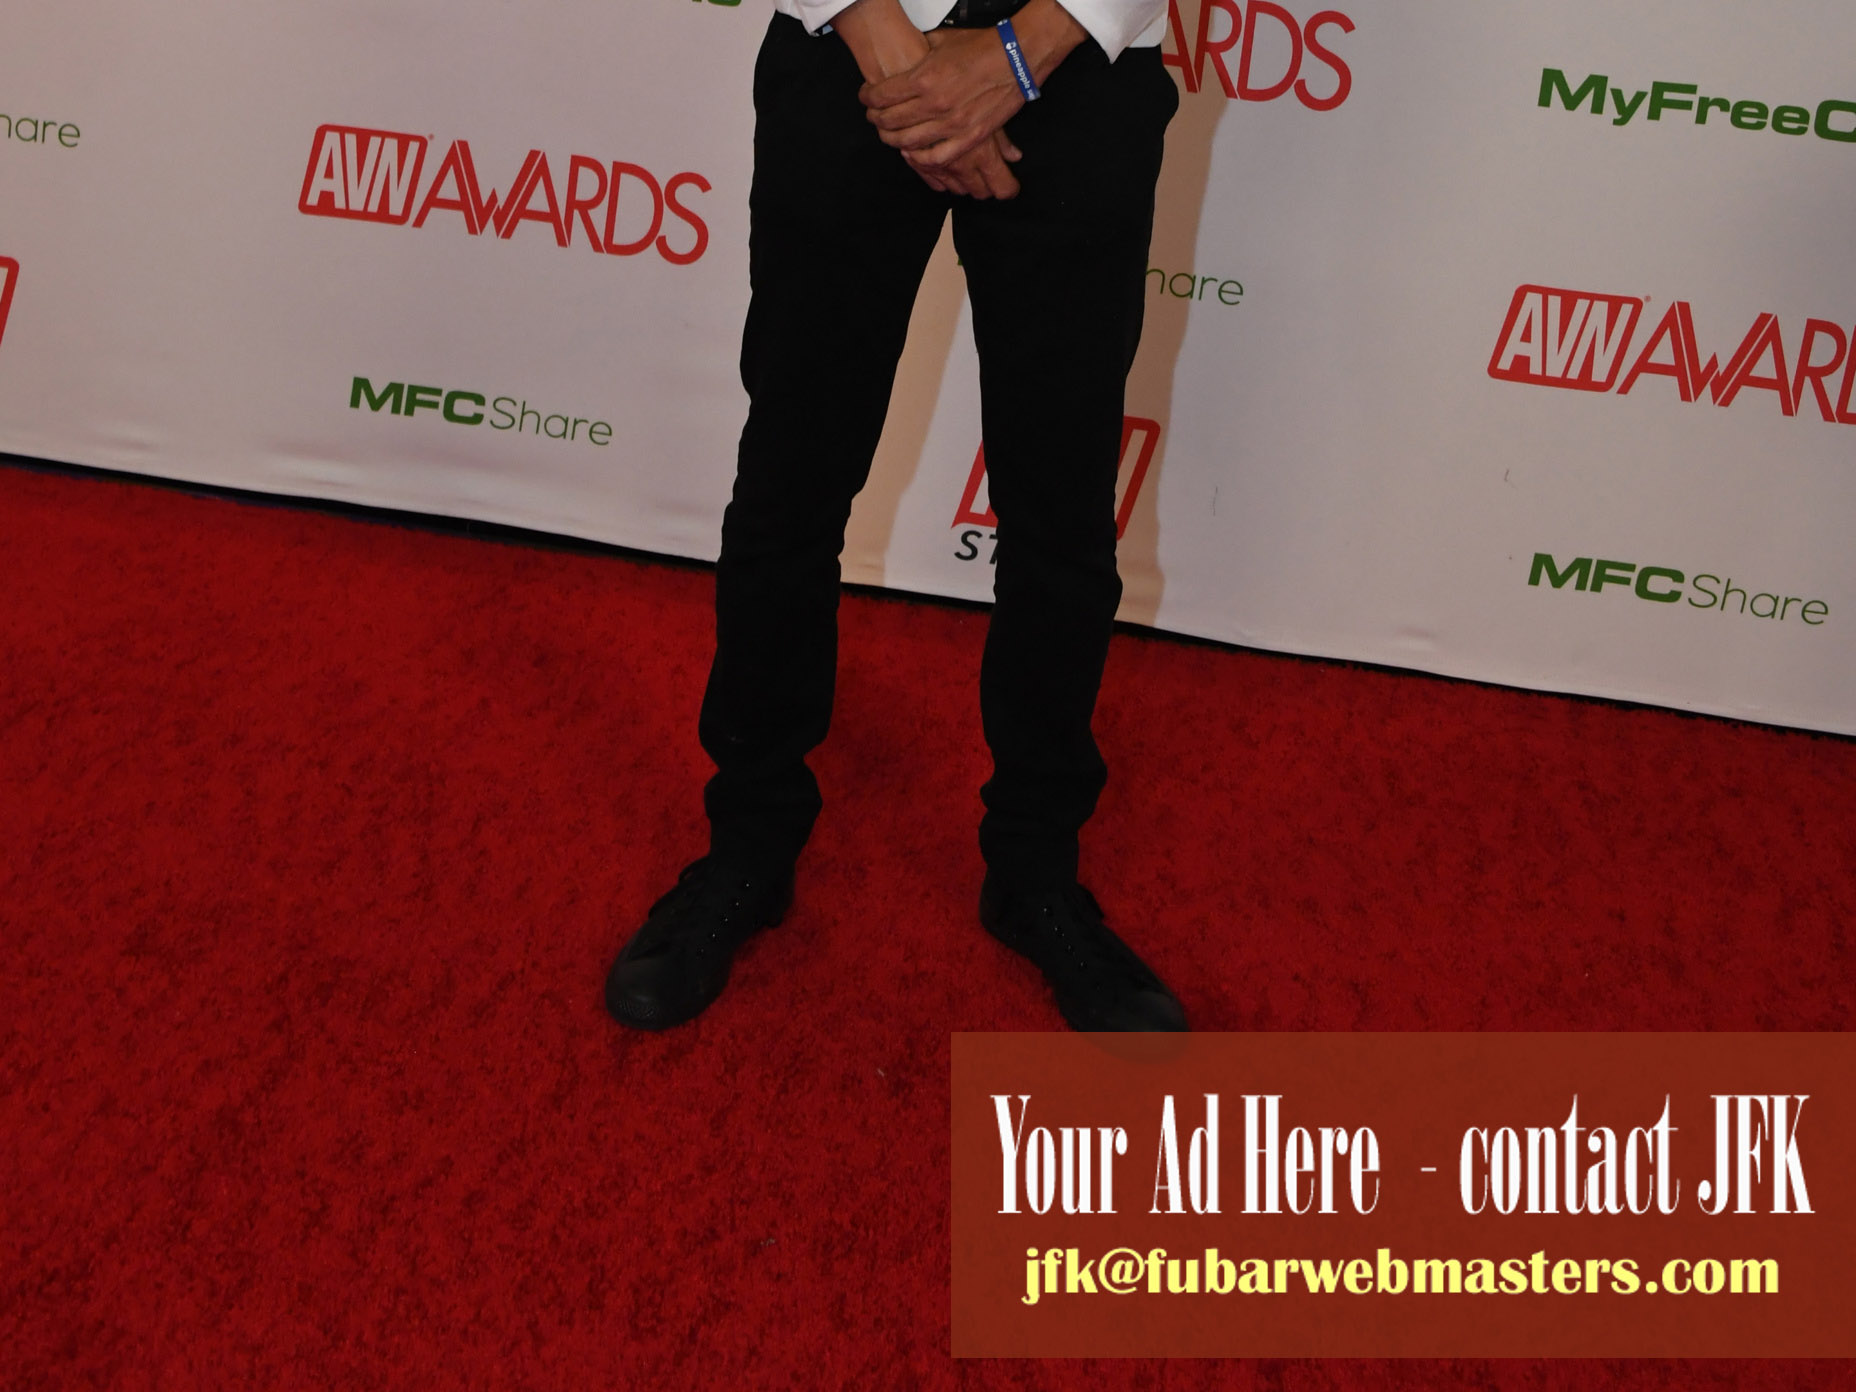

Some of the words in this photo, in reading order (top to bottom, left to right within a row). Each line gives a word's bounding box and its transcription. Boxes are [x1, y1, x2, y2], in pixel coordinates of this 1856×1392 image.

[1537, 67, 1856, 143] MyFreeC
[304, 130, 421, 217] AVN
[411, 138, 713, 266] AWARDS
[1495, 291, 1636, 384] AVN
[350, 376, 613, 446] MFCShare
[1527, 552, 1829, 625] MFCShare
